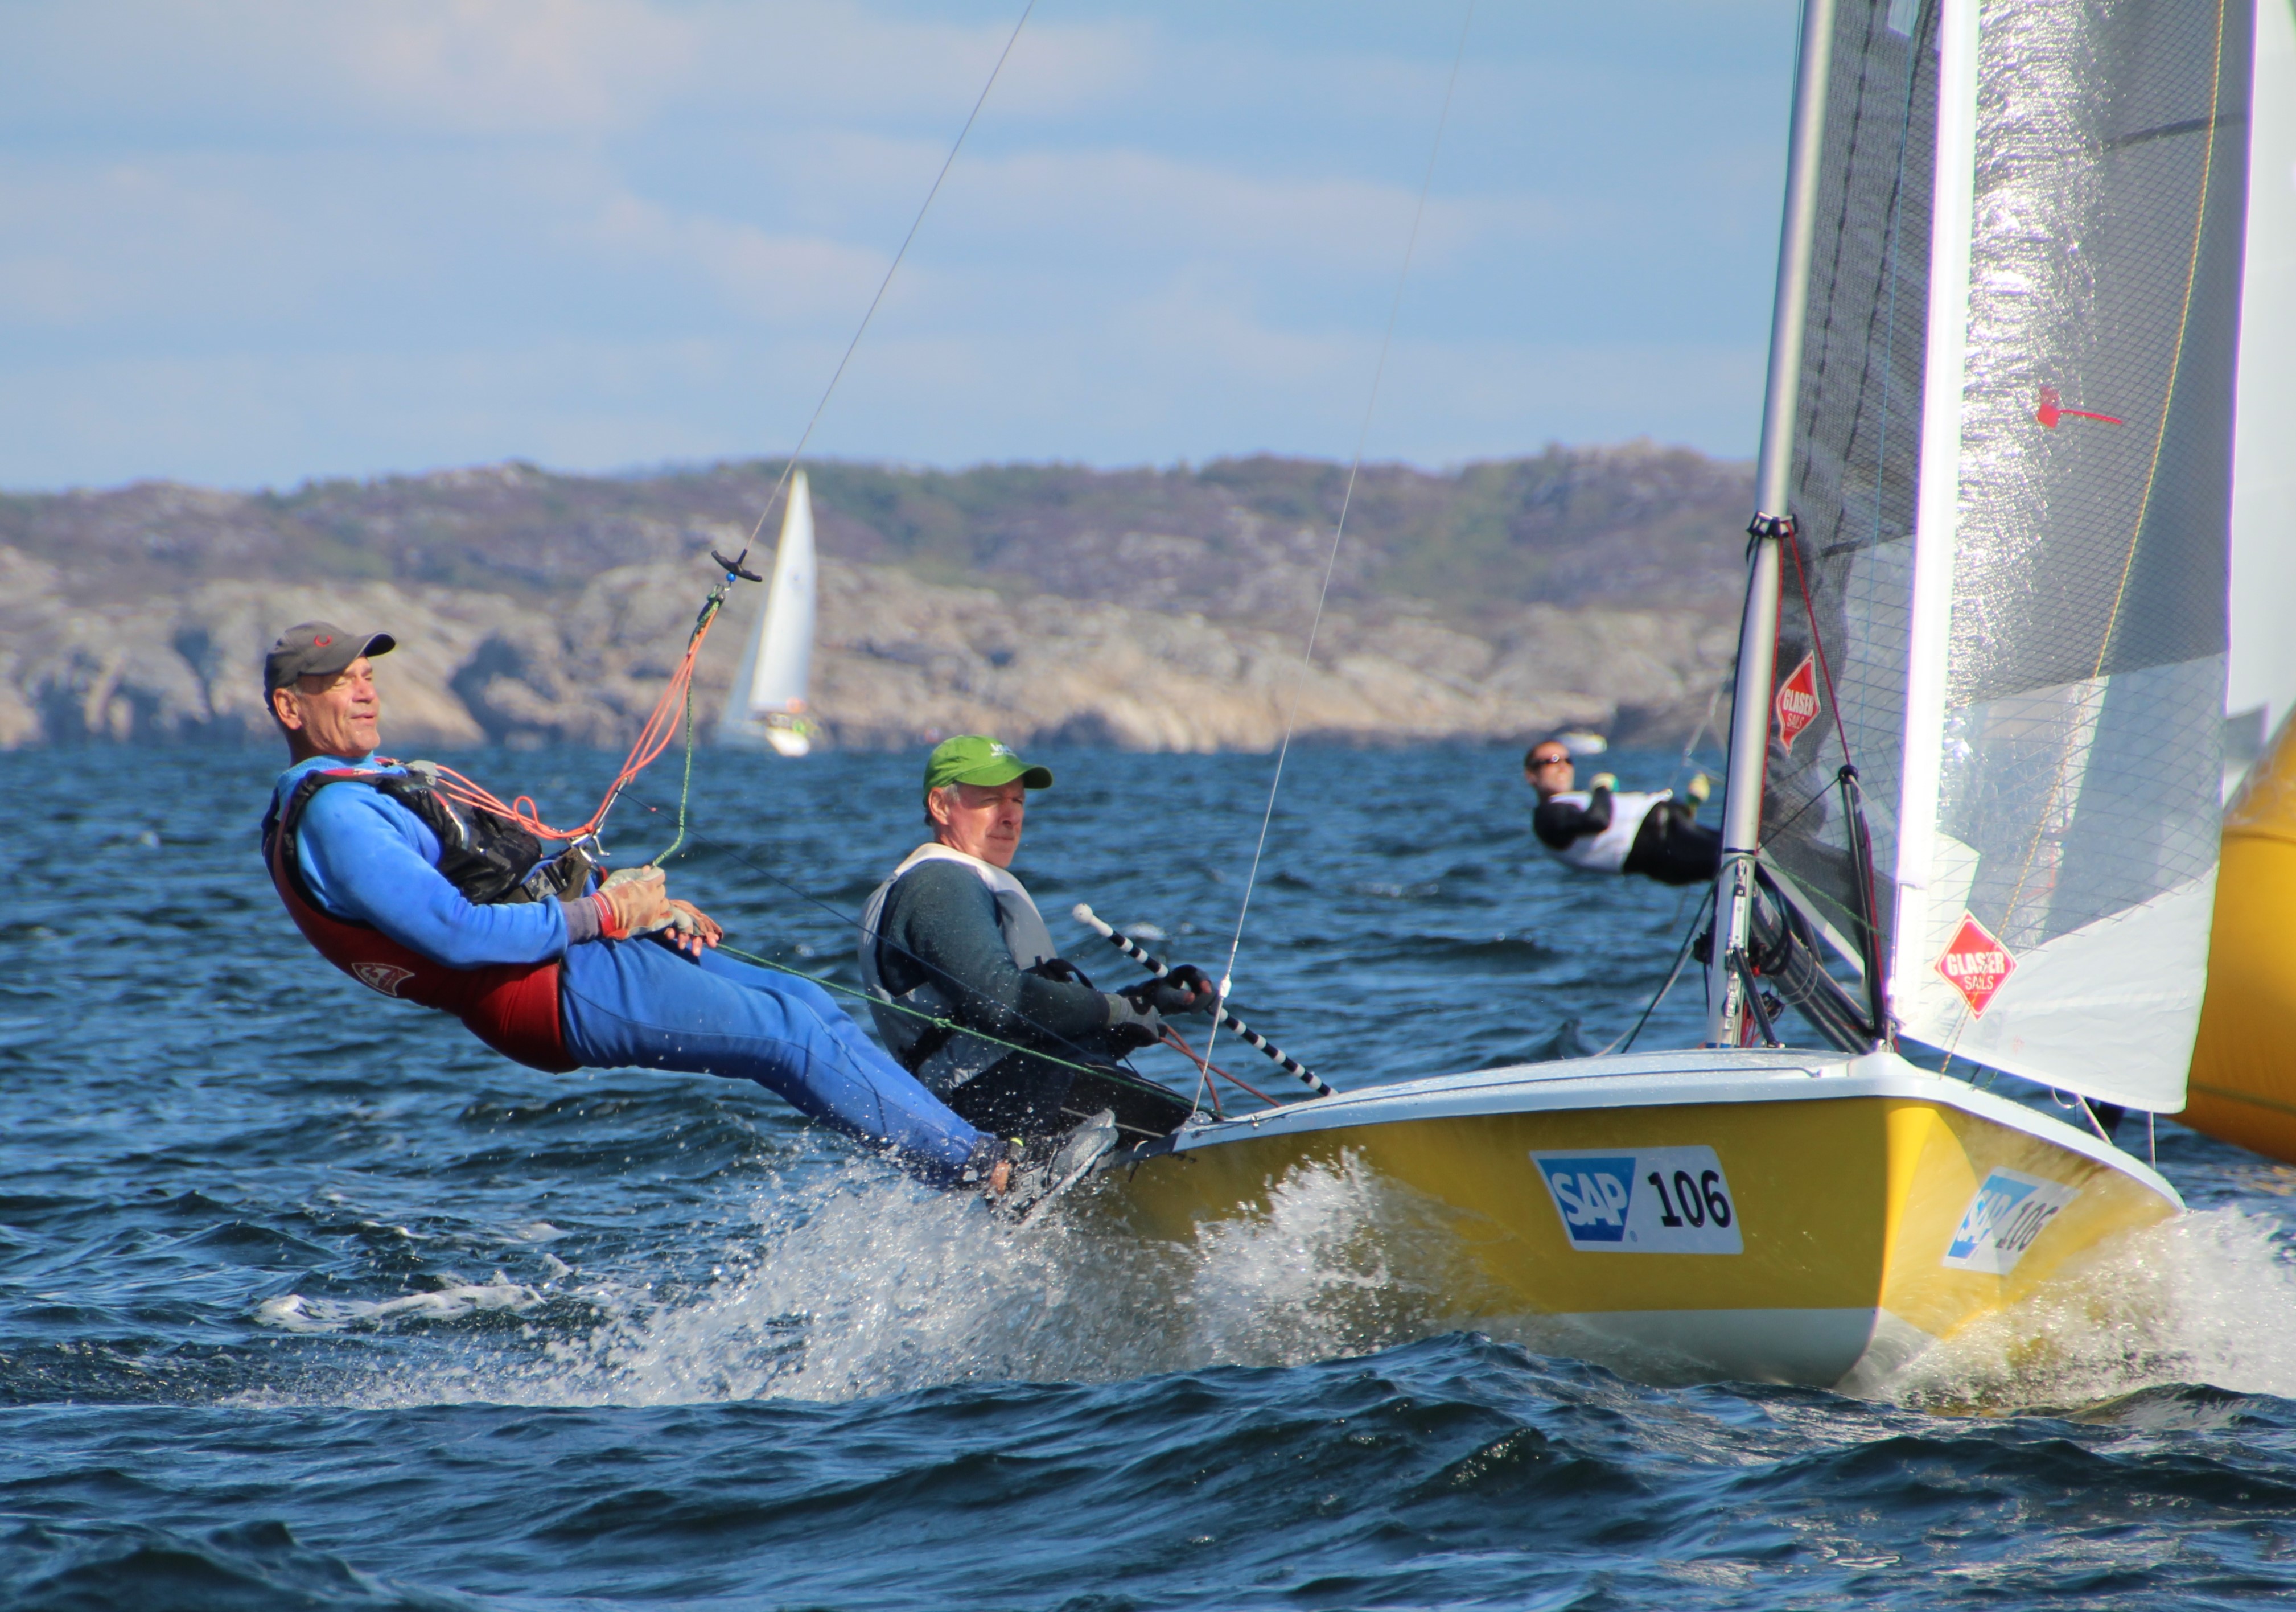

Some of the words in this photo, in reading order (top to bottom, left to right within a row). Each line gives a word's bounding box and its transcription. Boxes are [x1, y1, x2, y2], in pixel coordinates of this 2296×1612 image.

[1783, 688, 1814, 717] GLASER
[1787, 713, 1805, 729] SAILS
[1946, 952, 2005, 976] GLASER
[1551, 1172, 1628, 1225] SAP
[1647, 1170, 1731, 1228] 106
[1957, 1189, 2011, 1244] SAP
[1995, 1200, 2059, 1252] 106
